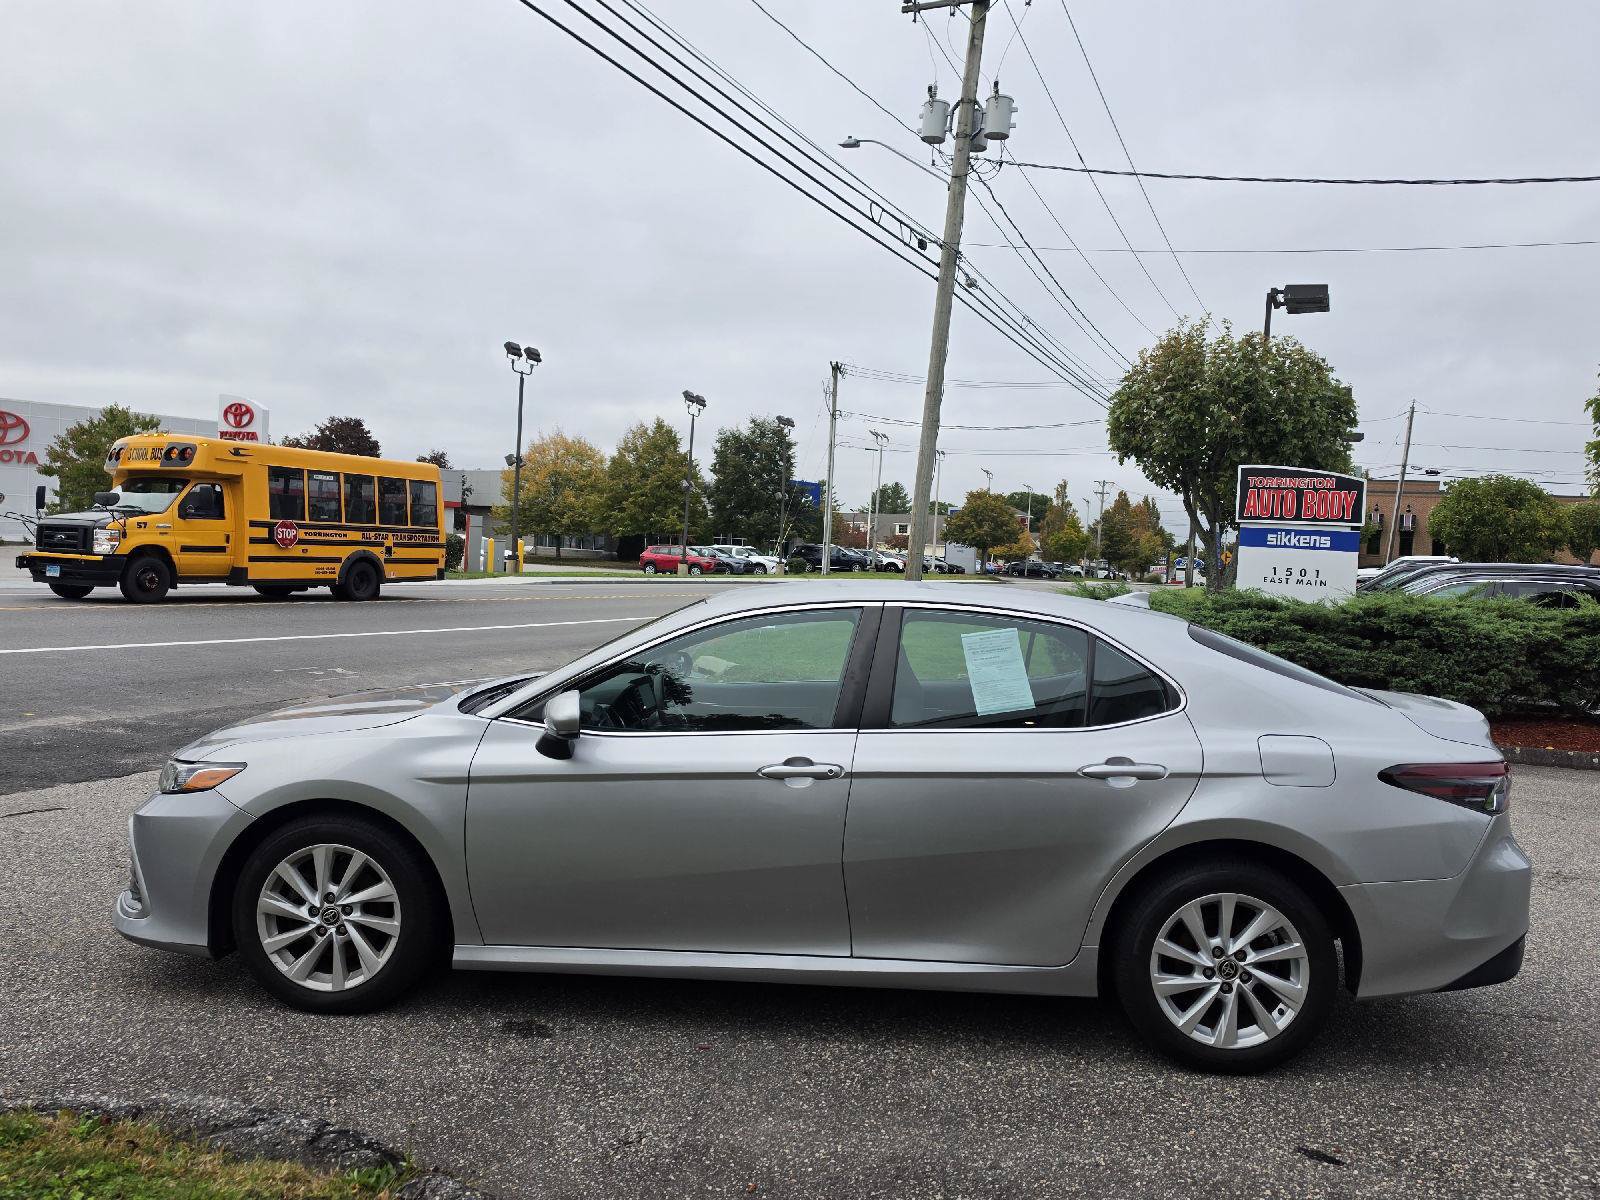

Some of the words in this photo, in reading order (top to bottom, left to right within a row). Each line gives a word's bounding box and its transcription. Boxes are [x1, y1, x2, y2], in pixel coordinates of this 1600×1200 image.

[149, 447, 163, 461] BUS
[1247, 476, 1336, 489] TORRINGTON
[1244, 489, 1297, 519] AUTO
[1302, 489, 1358, 520] BODY
[277, 528, 297, 539] STOP
[361, 532, 389, 541] ALL-STAR
[391, 533, 440, 543] TRANSPORTATION
[1266, 532, 1331, 548] sikkens
[1272, 567, 1320, 578] 1501
[1263, 576, 1291, 585] EAST
[1295, 577, 1328, 587] MAIN
